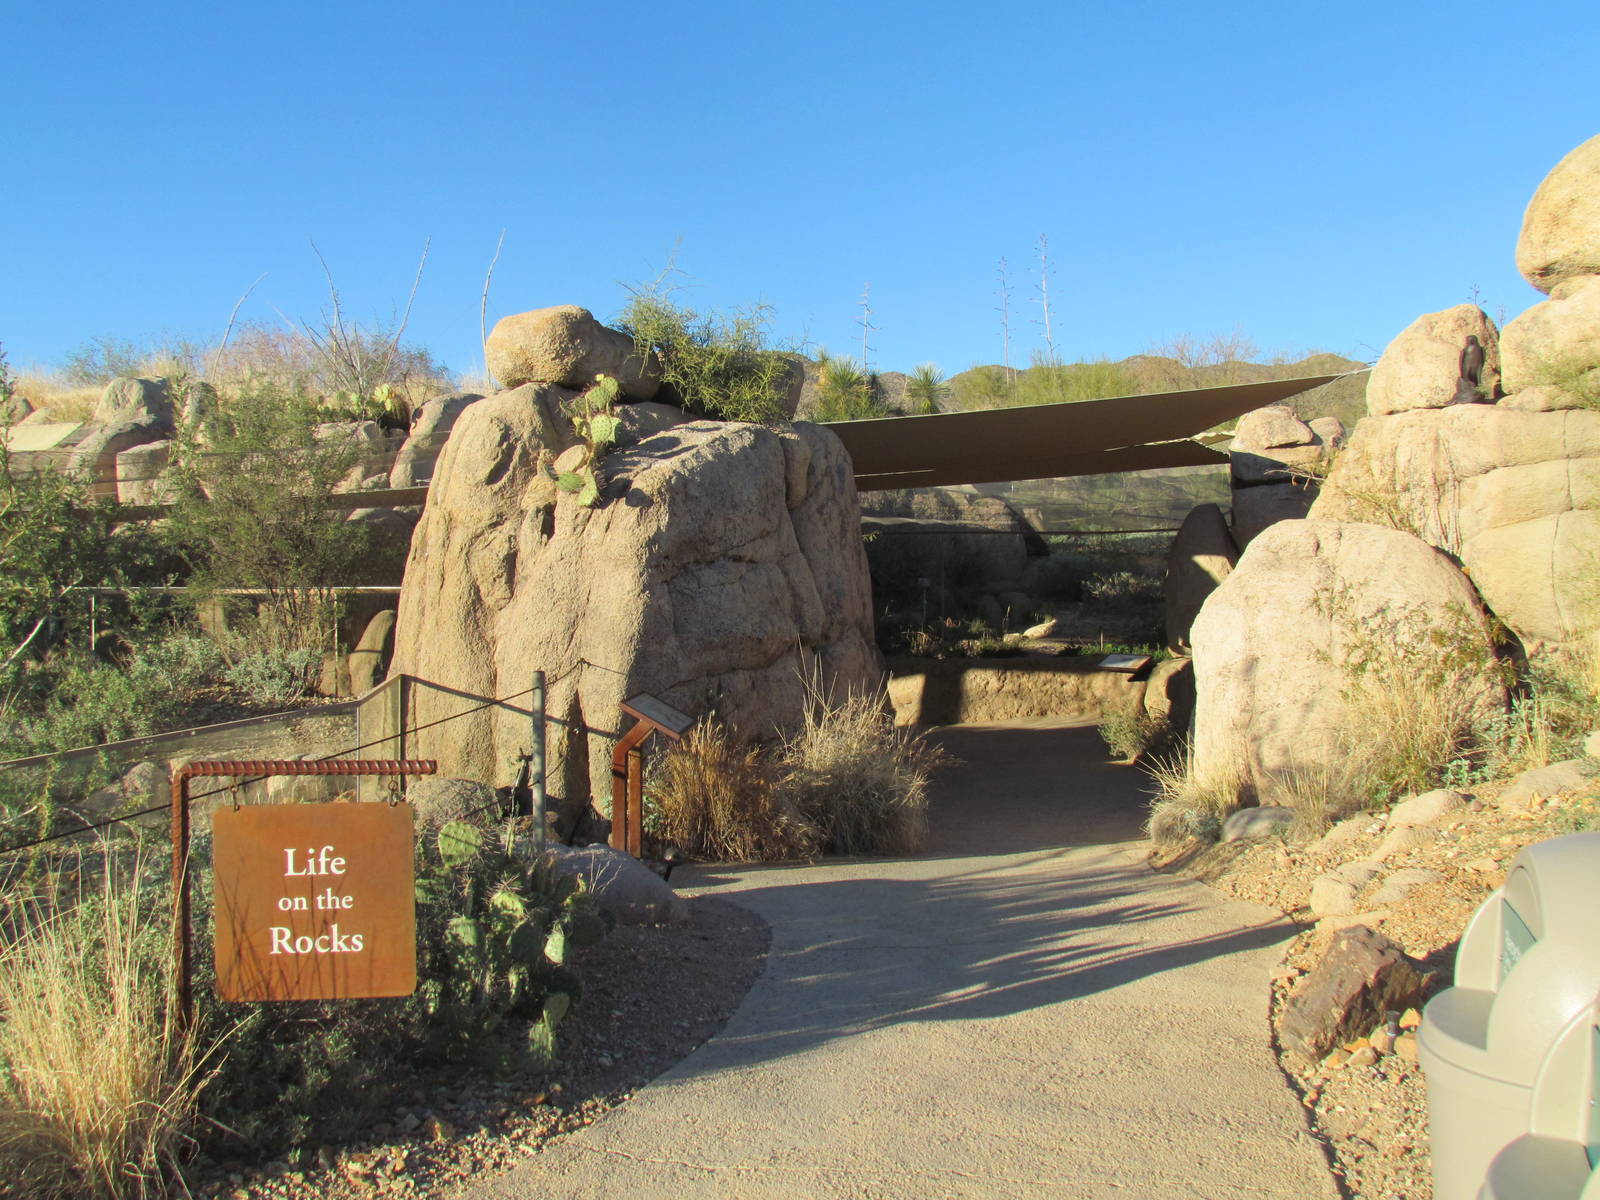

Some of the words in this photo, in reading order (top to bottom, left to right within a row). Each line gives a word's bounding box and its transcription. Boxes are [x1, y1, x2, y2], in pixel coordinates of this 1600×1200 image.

[284, 845, 346, 876] Life
[278, 896, 308, 911] on
[317, 888, 353, 910] the
[269, 924, 364, 955] Rocks
